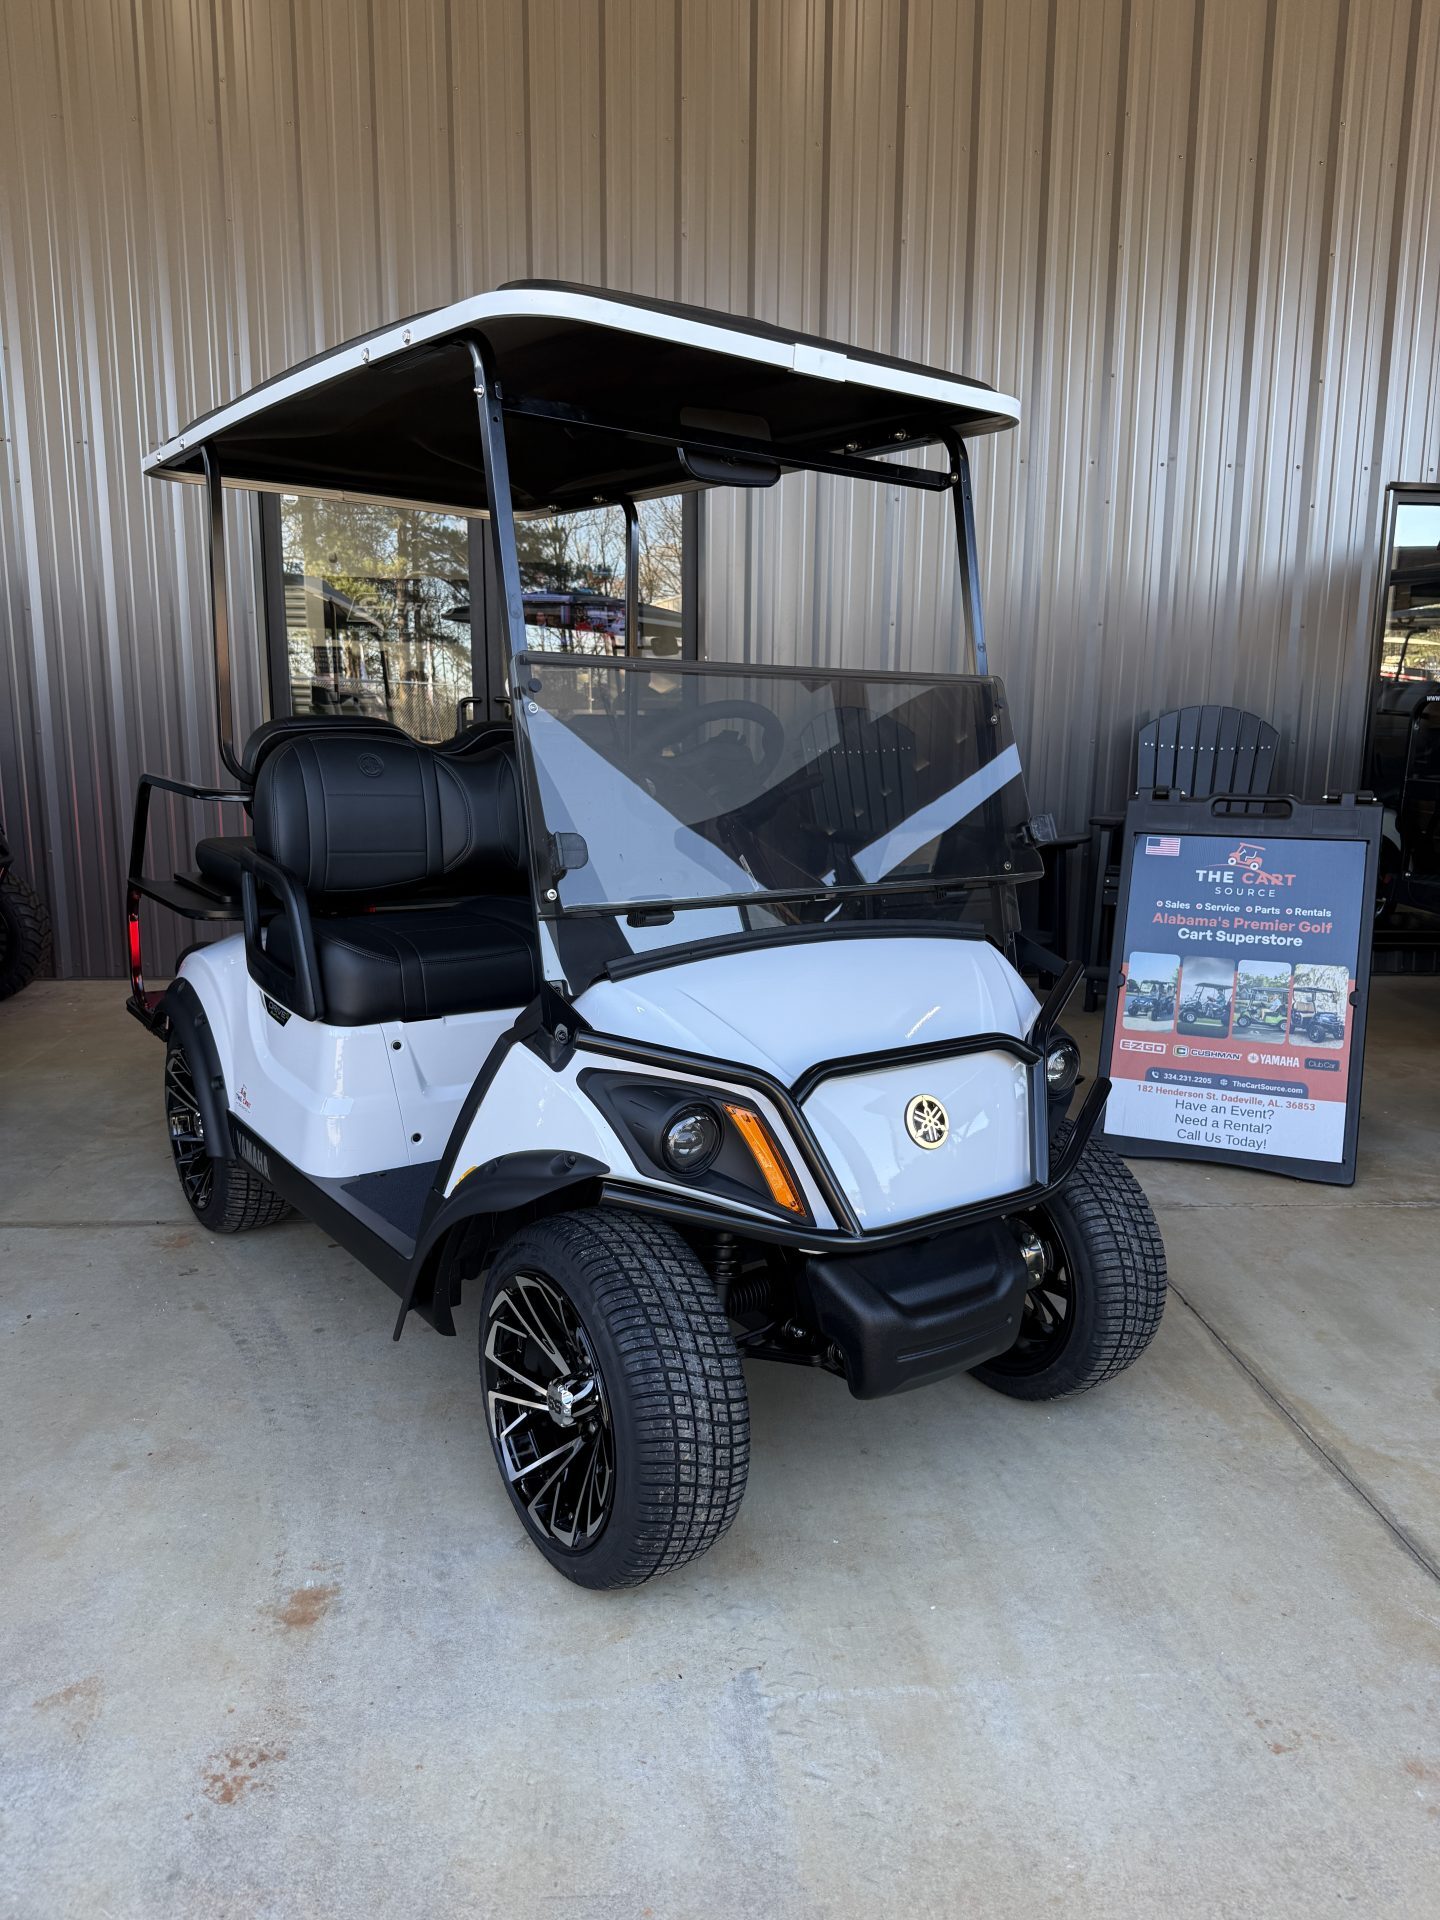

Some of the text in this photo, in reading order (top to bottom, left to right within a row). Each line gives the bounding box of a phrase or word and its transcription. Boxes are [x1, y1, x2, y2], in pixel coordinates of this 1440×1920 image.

[1196, 870, 1296, 886] THE CART
[1215, 887, 1276, 897] SOURCE
[1165, 900, 1331, 917] Sales Service Parts Rentals
[1152, 912, 1333, 934] Alabama's Premier Golf
[1178, 928, 1303, 947] Cart Superstore
[1191, 1049, 1240, 1060] CUSHMAN
[1260, 1054, 1300, 1067] YAMAHA
[1163, 1072, 1303, 1094] 334.231.2205 TheCartSource.com
[1137, 1084, 1316, 1111] 182 Henderson St. Dadeville, AL. 36853
[1175, 1099, 1275, 1120] Have an Event?
[1175, 1114, 1272, 1134] Need a Rental?
[1177, 1129, 1267, 1151] Call Us Today!
[237, 1130, 271, 1181] YAMAHA
